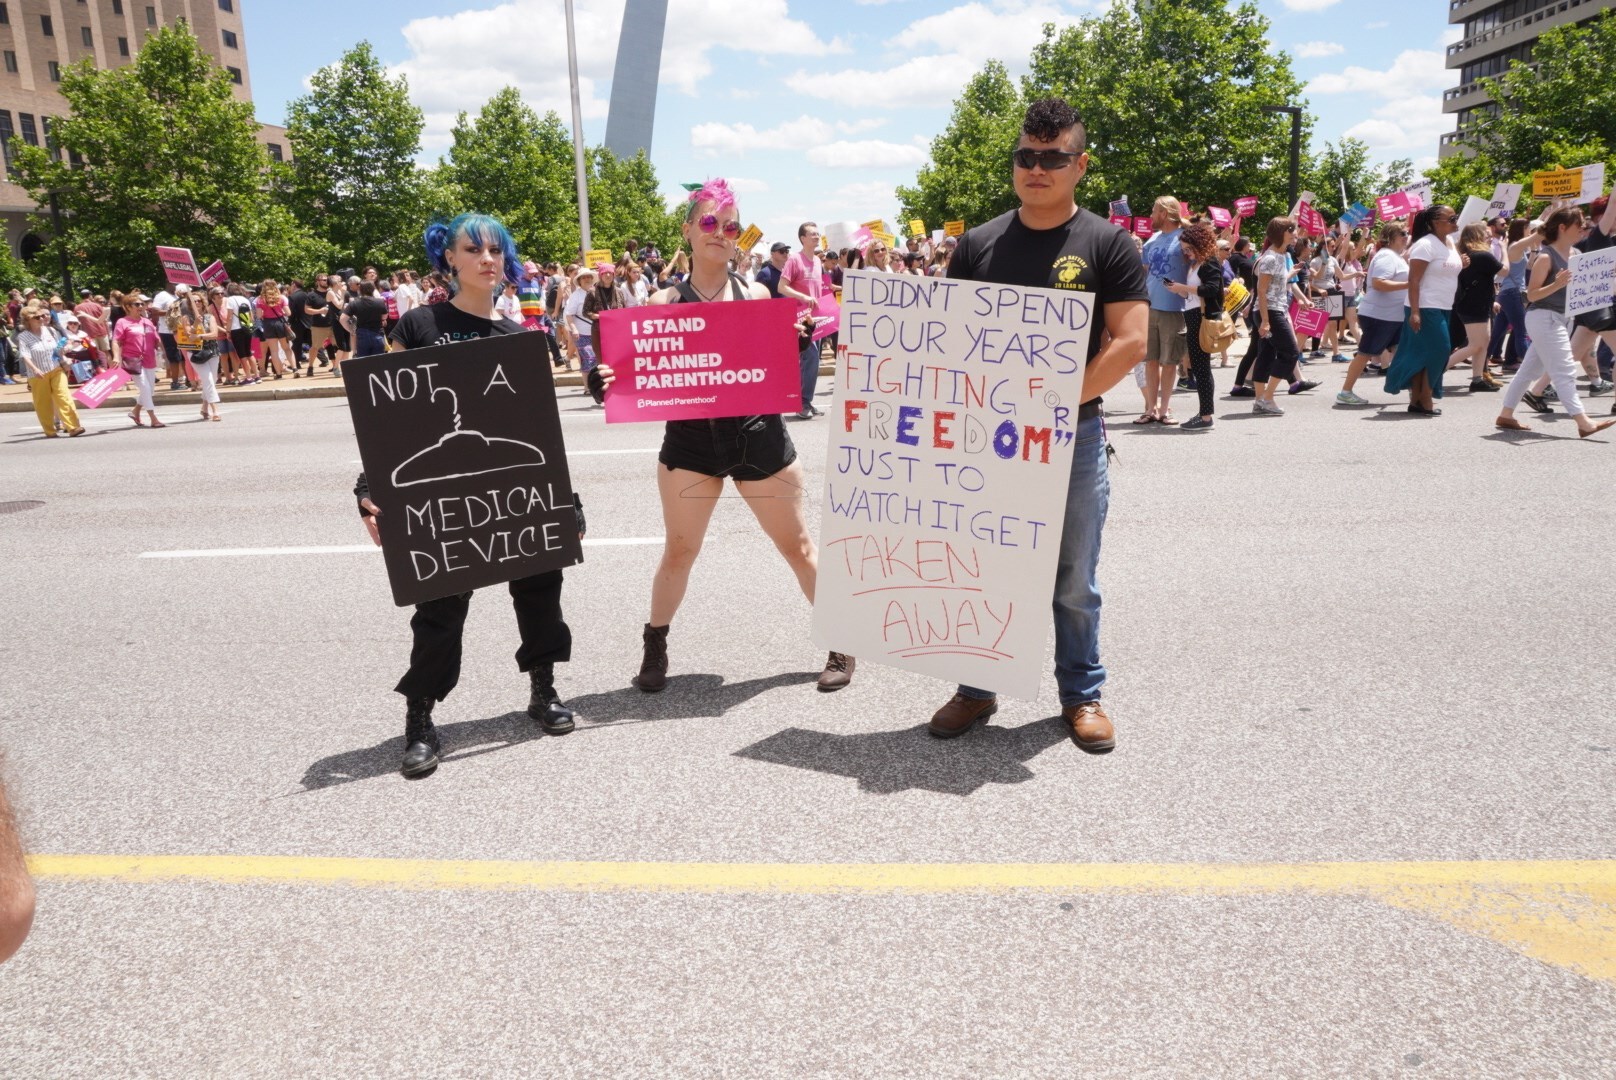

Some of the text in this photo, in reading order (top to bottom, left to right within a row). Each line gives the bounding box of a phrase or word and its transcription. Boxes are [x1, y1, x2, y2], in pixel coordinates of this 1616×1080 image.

[1543, 178, 1572, 186] SHAME
[177, 263, 194, 271] LEGAL
[1573, 274, 1587, 284] FOR
[1590, 272, 1599, 281] MY
[1578, 256, 1614, 271] GRATEFUL
[846, 275, 1090, 331] I DIDN'T SPEND
[631, 317, 706, 335] I STAND
[633, 337, 684, 353] WITH
[850, 312, 1078, 374] FOUR YEARS
[634, 353, 722, 371] PLANNED
[369, 363, 516, 406] NOT A
[645, 396, 717, 407] Planned Parenthood
[838, 446, 985, 492] JUST TO
[406, 483, 573, 540] MEDICAL
[829, 483, 1046, 549] WATCH IT GET
[410, 523, 562, 581] DEVICE
[826, 535, 980, 583] TAKEN
[883, 599, 1013, 649] AWAY
